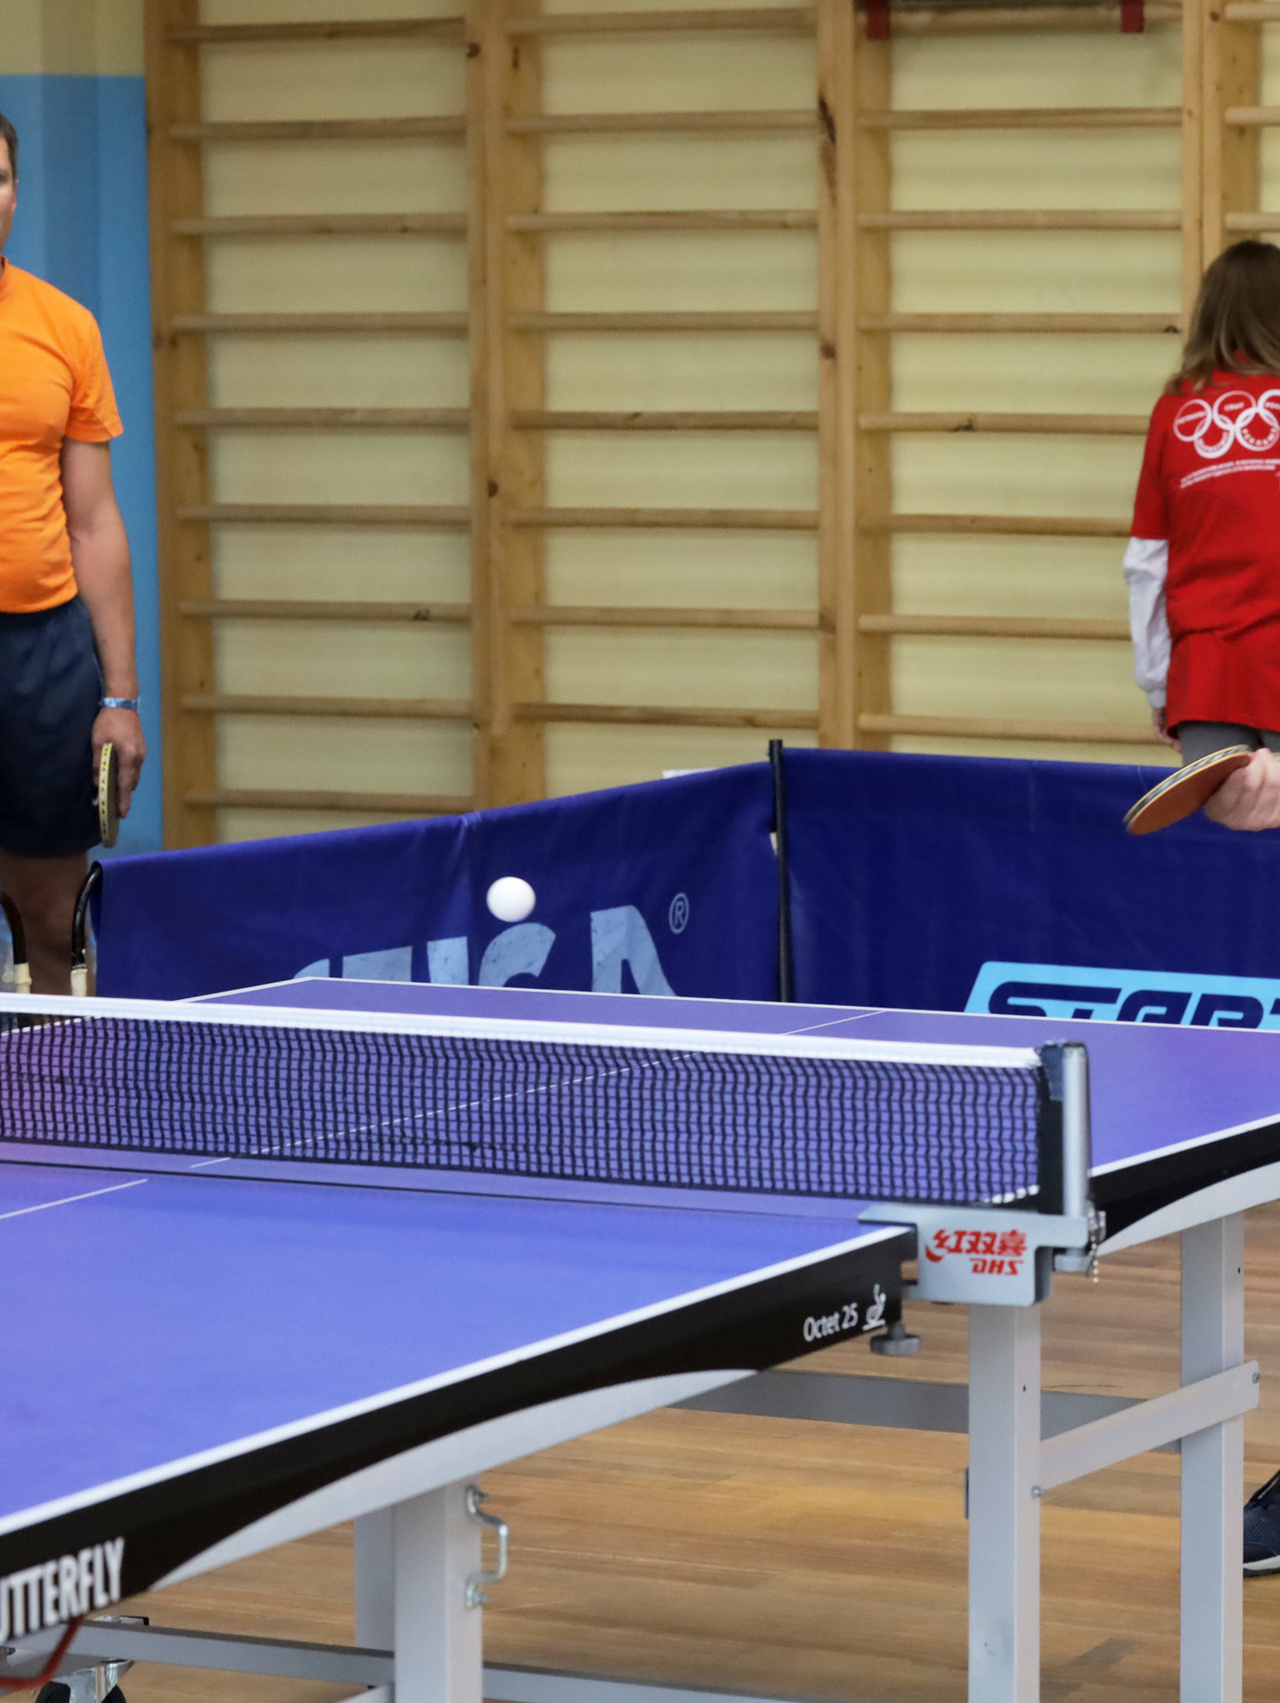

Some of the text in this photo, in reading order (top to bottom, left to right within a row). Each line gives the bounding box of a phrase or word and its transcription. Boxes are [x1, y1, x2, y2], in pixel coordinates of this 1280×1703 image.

[969, 1258, 1024, 1276] DHS
[803, 1302, 859, 1342] Octet 25
